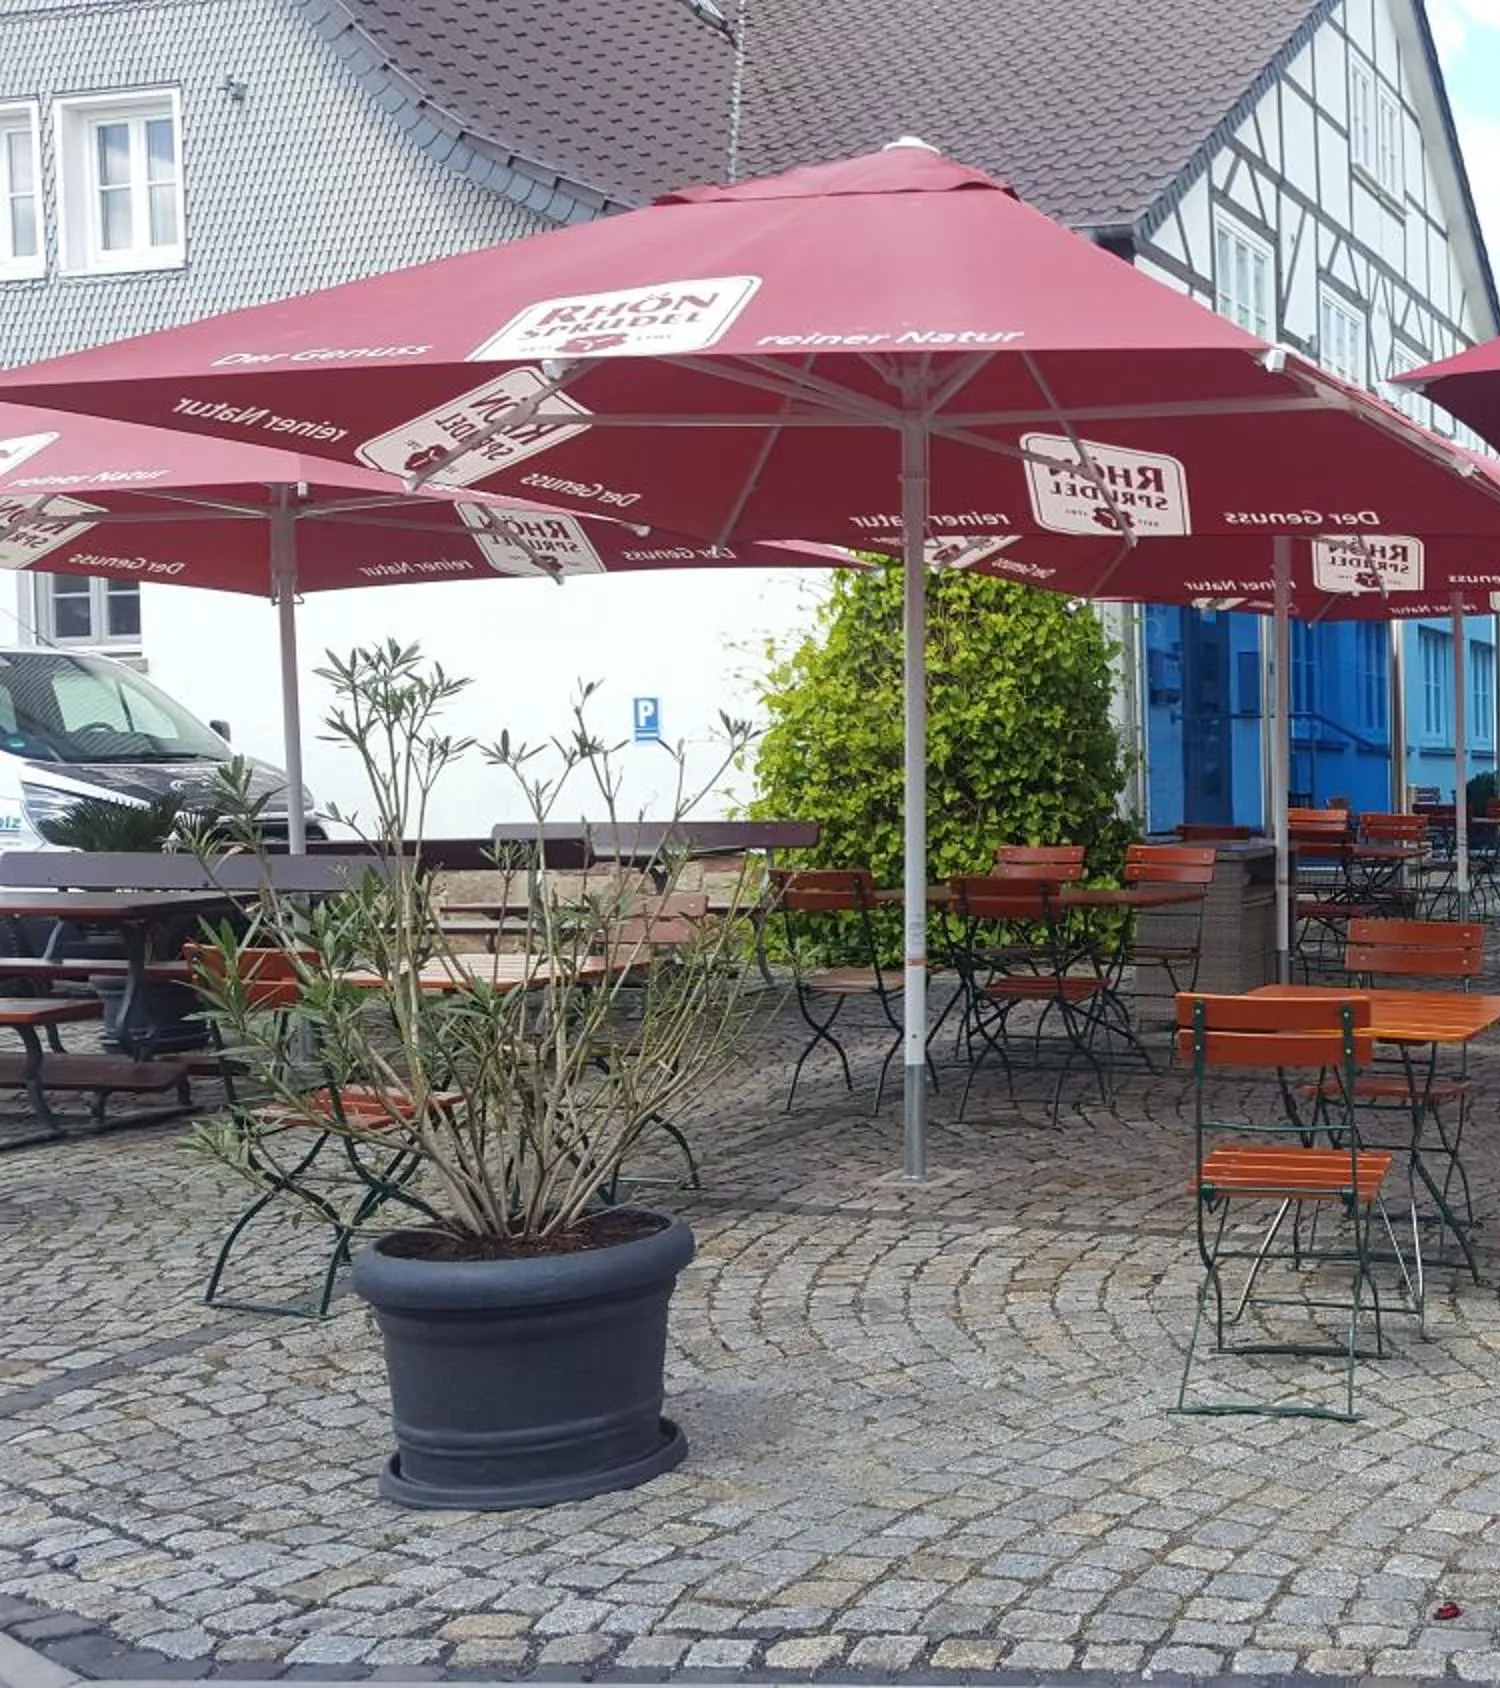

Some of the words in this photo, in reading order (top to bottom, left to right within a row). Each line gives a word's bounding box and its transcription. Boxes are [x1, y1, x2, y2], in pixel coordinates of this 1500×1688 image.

[535, 291, 721, 328] RHÖN
[516, 311, 707, 342] SPRUDEL
[757, 331, 891, 347] reiner
[895, 329, 1025, 345] Natur
